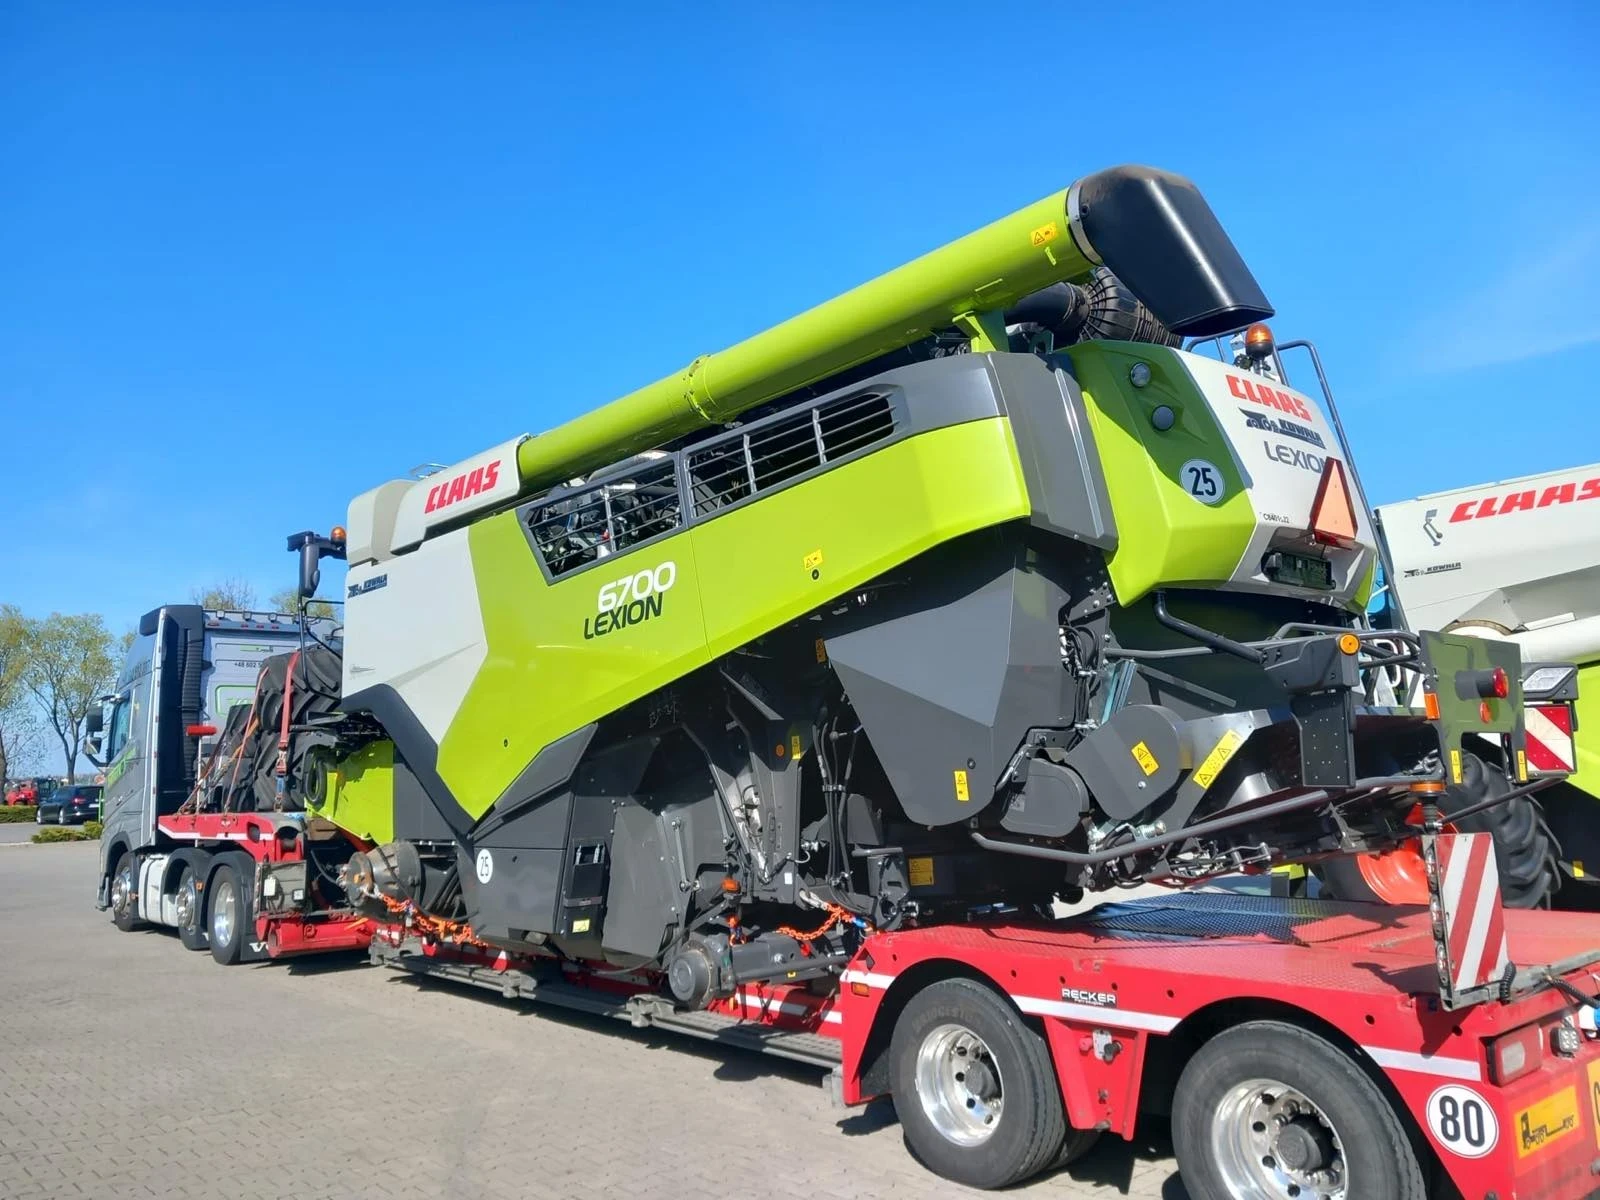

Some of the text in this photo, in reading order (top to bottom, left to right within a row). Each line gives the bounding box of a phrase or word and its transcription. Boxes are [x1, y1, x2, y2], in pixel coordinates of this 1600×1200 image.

[1226, 374, 1312, 422] CLAAS
[424, 460, 501, 514] CLAAS
[1188, 466, 1217, 496] 25
[597, 561, 676, 613] 6700
[584, 592, 663, 640] LEXION
[480, 856, 490, 877] 25
[1062, 988, 1116, 1004] RECKER
[1439, 1095, 1486, 1148] 80
